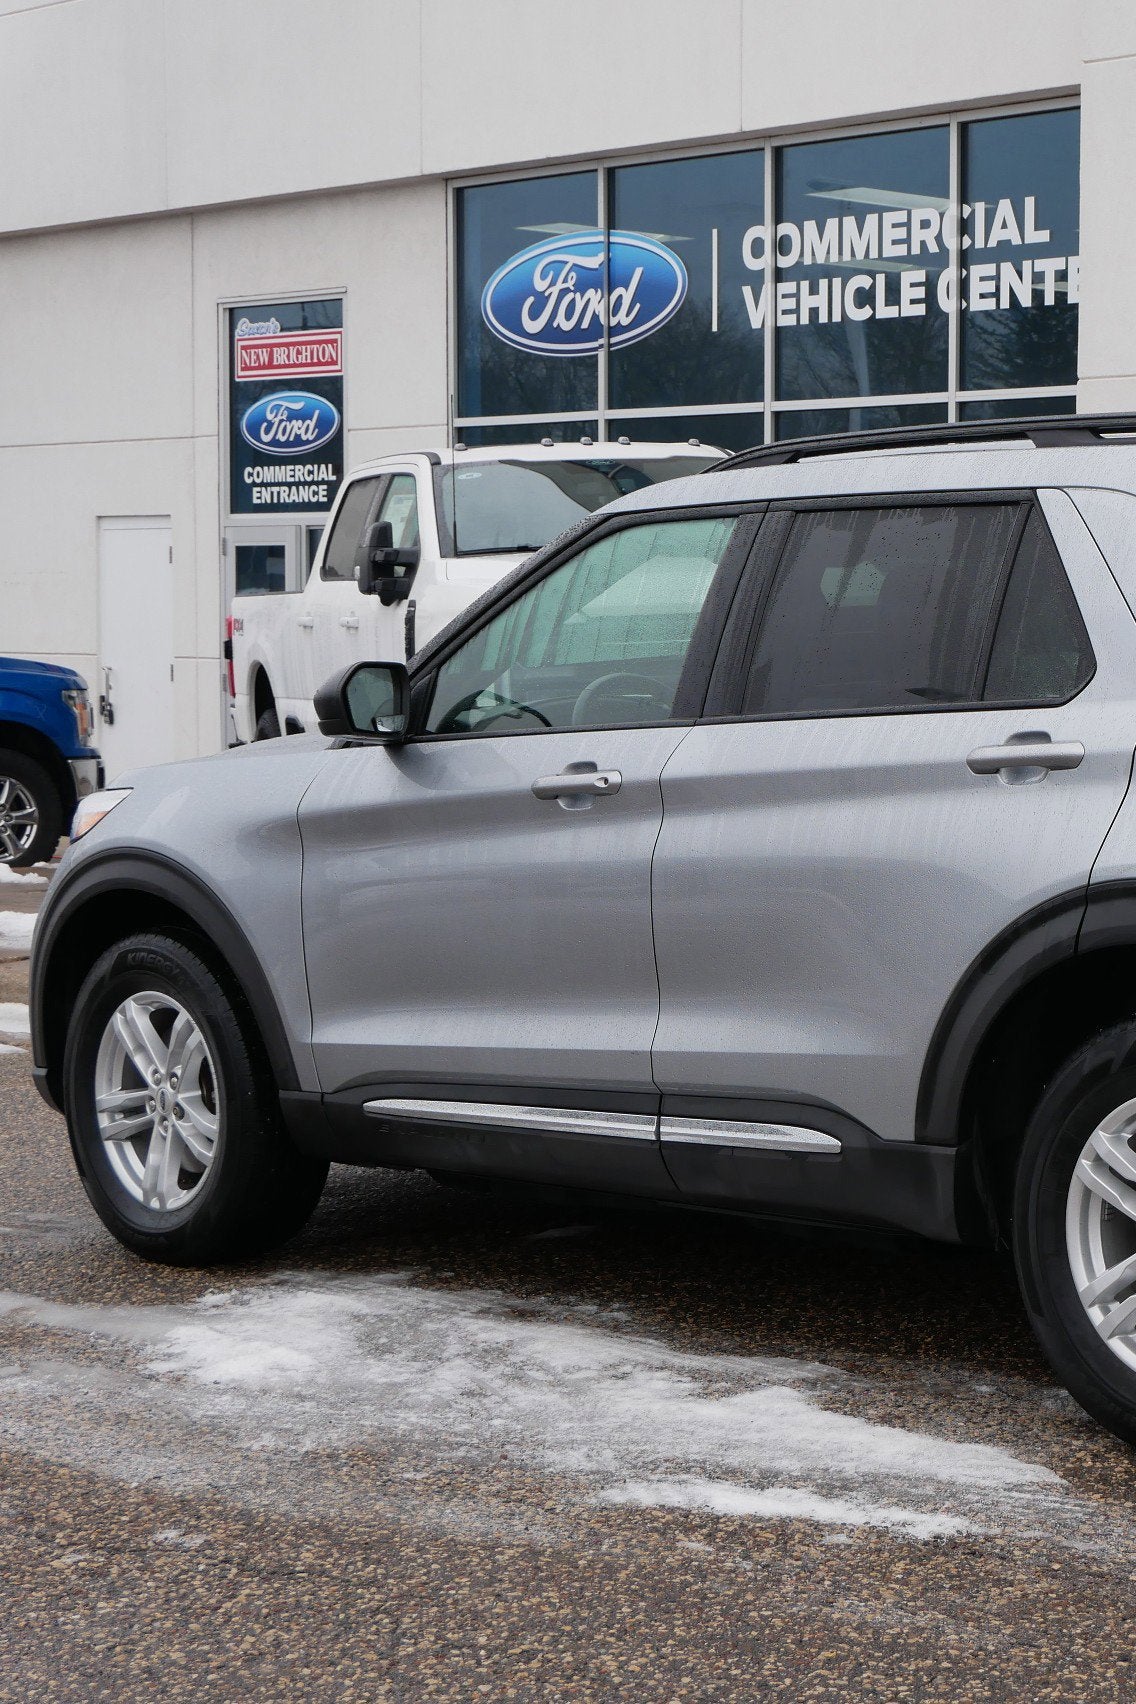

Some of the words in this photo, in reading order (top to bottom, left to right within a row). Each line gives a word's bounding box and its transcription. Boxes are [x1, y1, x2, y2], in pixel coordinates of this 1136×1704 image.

[742, 196, 1050, 271] COMMERCIAL
[521, 252, 641, 333] Ford
[741, 269, 926, 329] VEHICLE
[241, 348, 270, 367] NEW
[273, 343, 337, 365] BRIGHTON
[260, 400, 320, 442] Ford
[244, 464, 336, 483] COMMERCIAL
[252, 485, 328, 503] ENTRANCE
